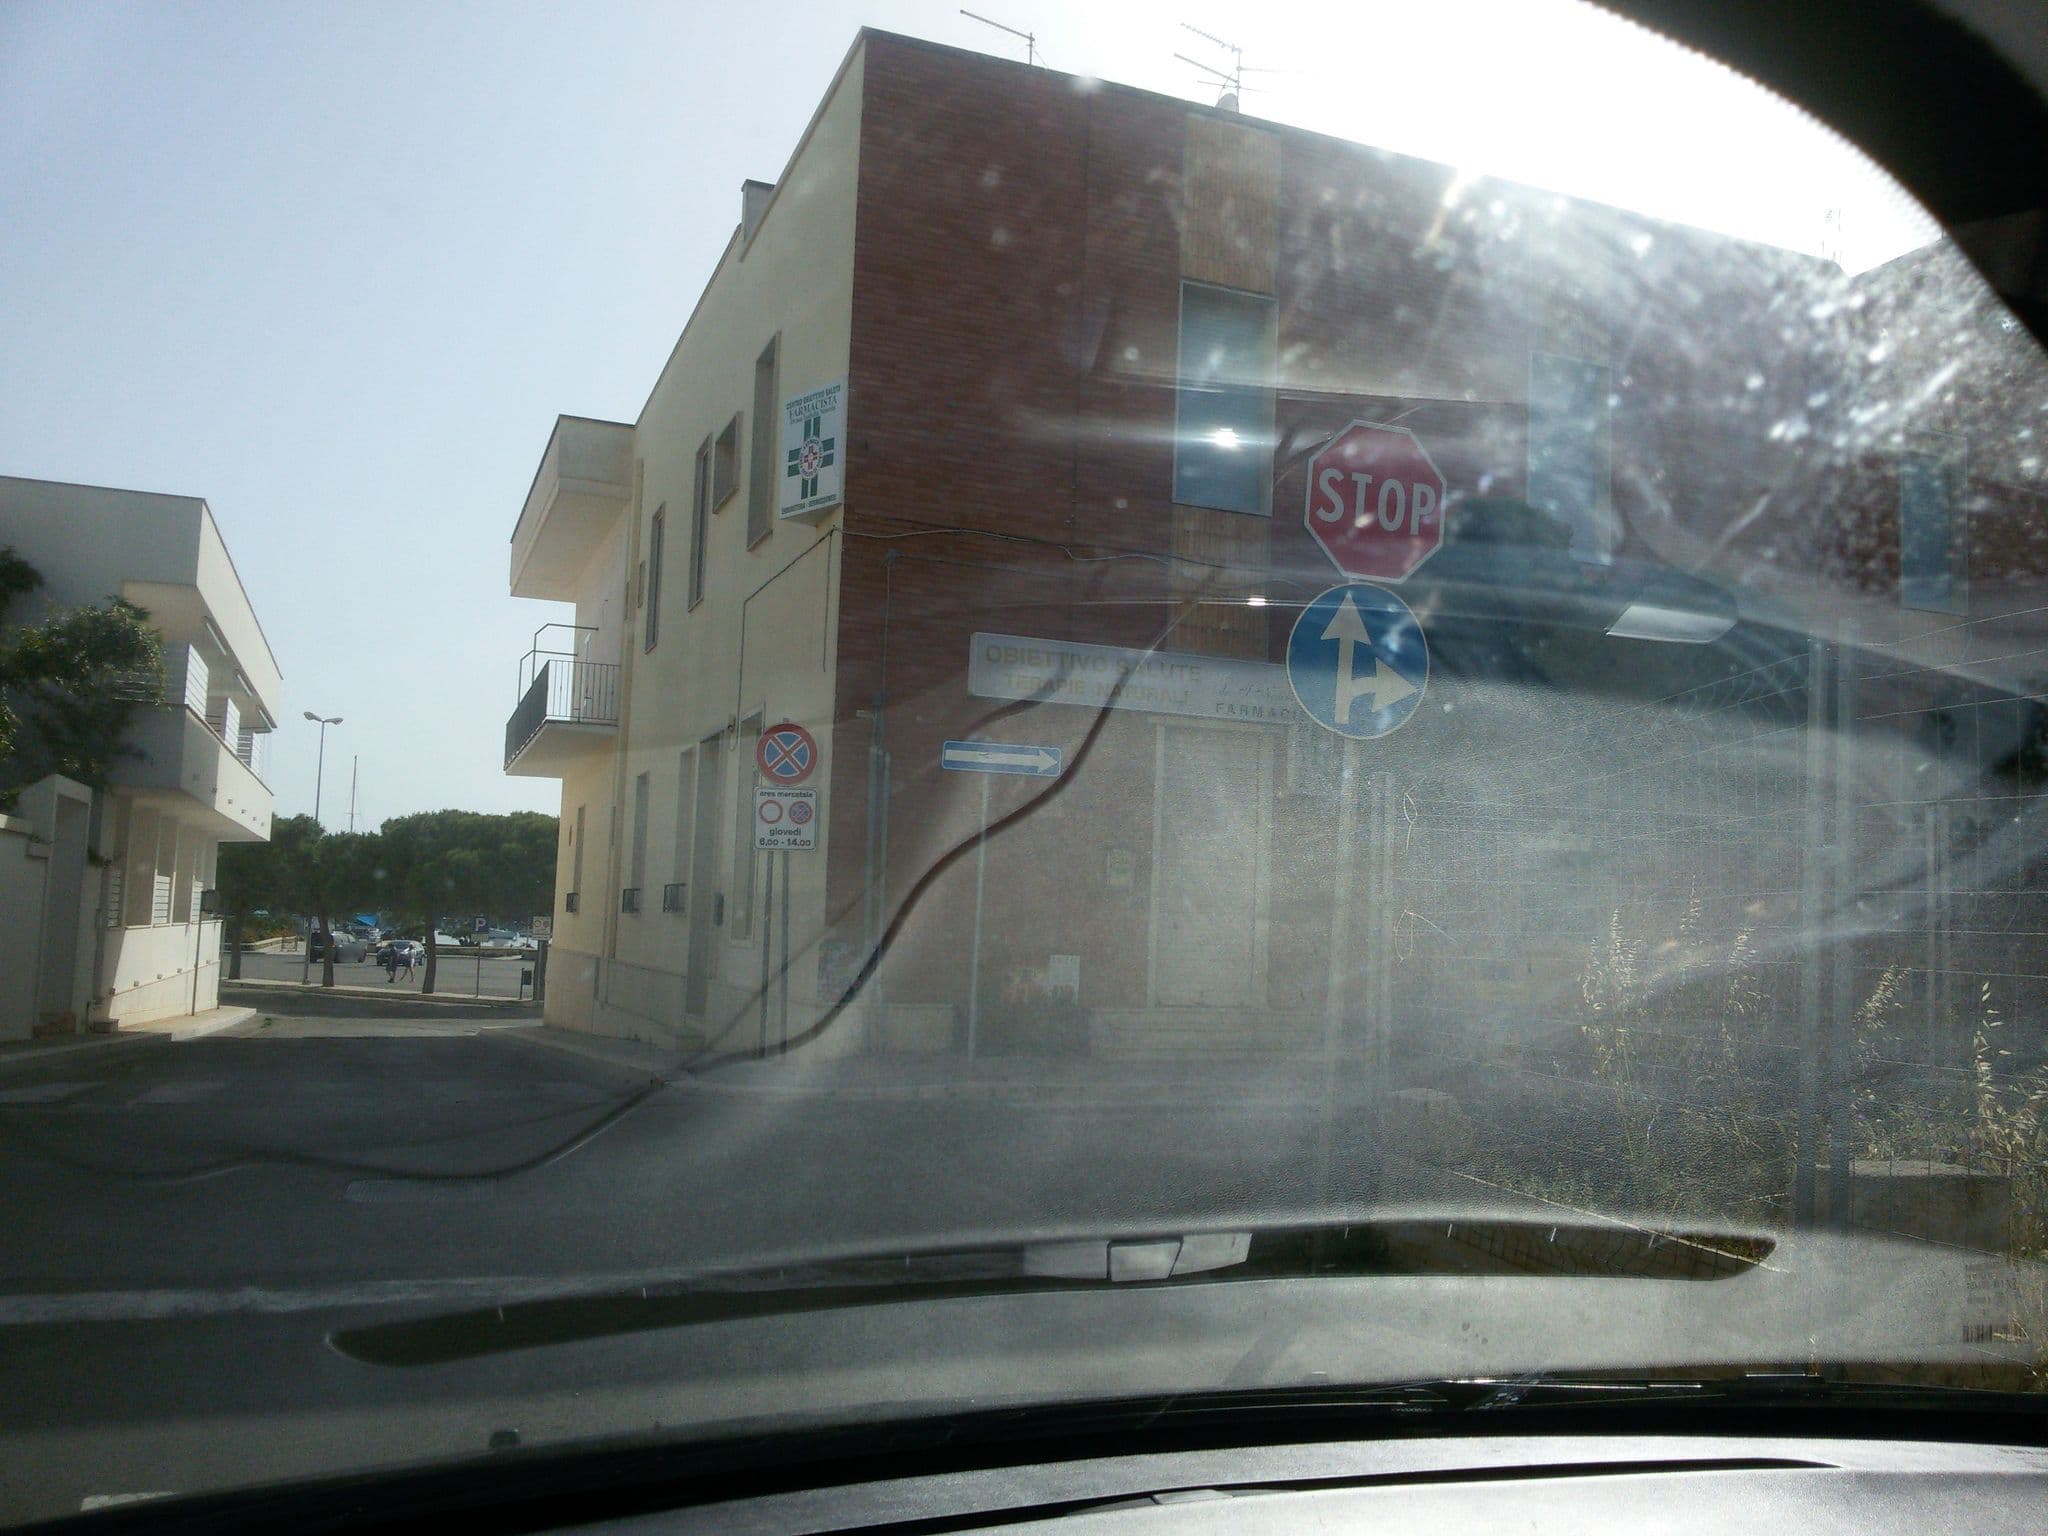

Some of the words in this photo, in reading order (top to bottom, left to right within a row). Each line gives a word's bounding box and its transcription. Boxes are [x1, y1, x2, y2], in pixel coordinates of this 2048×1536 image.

[1315, 468, 1436, 536] STOP
[985, 645, 1107, 674] OBIETTIVO
[1115, 655, 1200, 682] SALUTE
[475, 917, 487, 932] P
